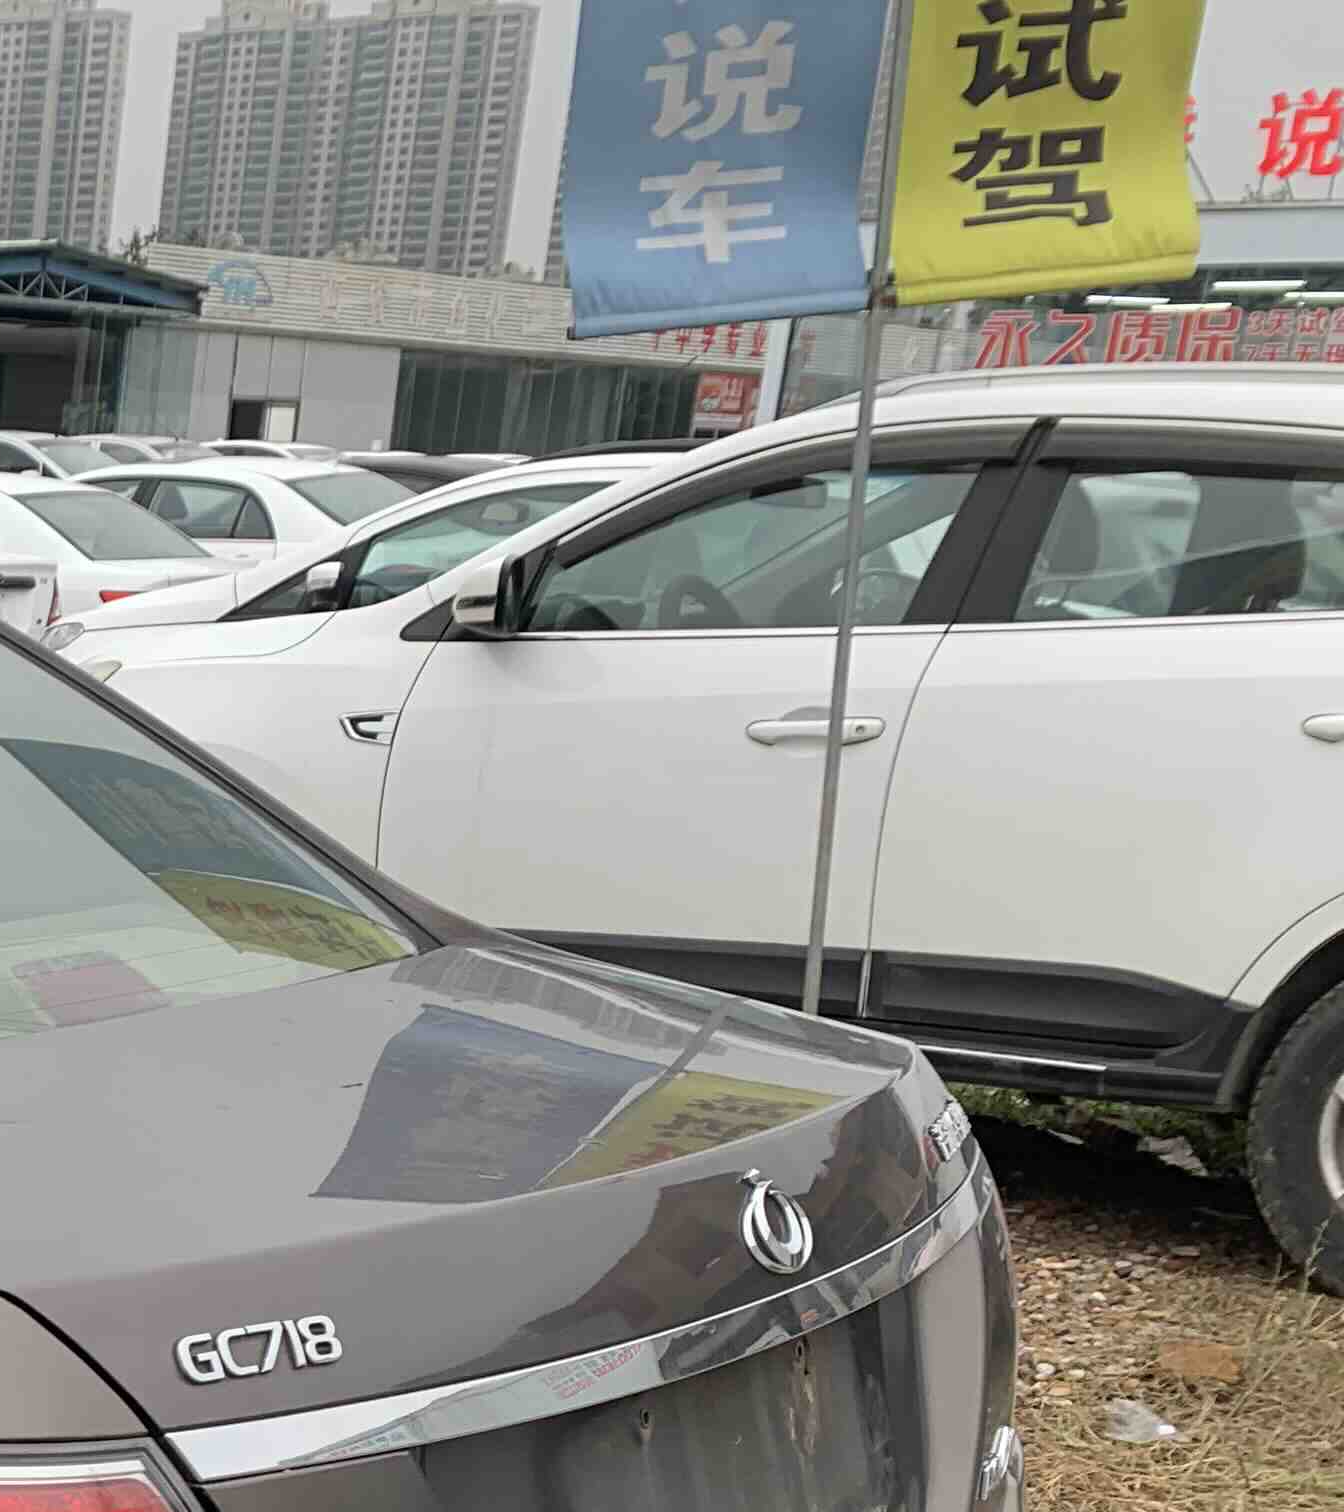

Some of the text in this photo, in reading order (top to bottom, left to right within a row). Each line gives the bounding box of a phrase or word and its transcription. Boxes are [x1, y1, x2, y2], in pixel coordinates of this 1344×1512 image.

[636, 19, 803, 264] 说车
[951, 0, 1125, 227] 试驾
[975, 307, 1243, 368] 永久质保
[175, 1314, 344, 1384] GC718
